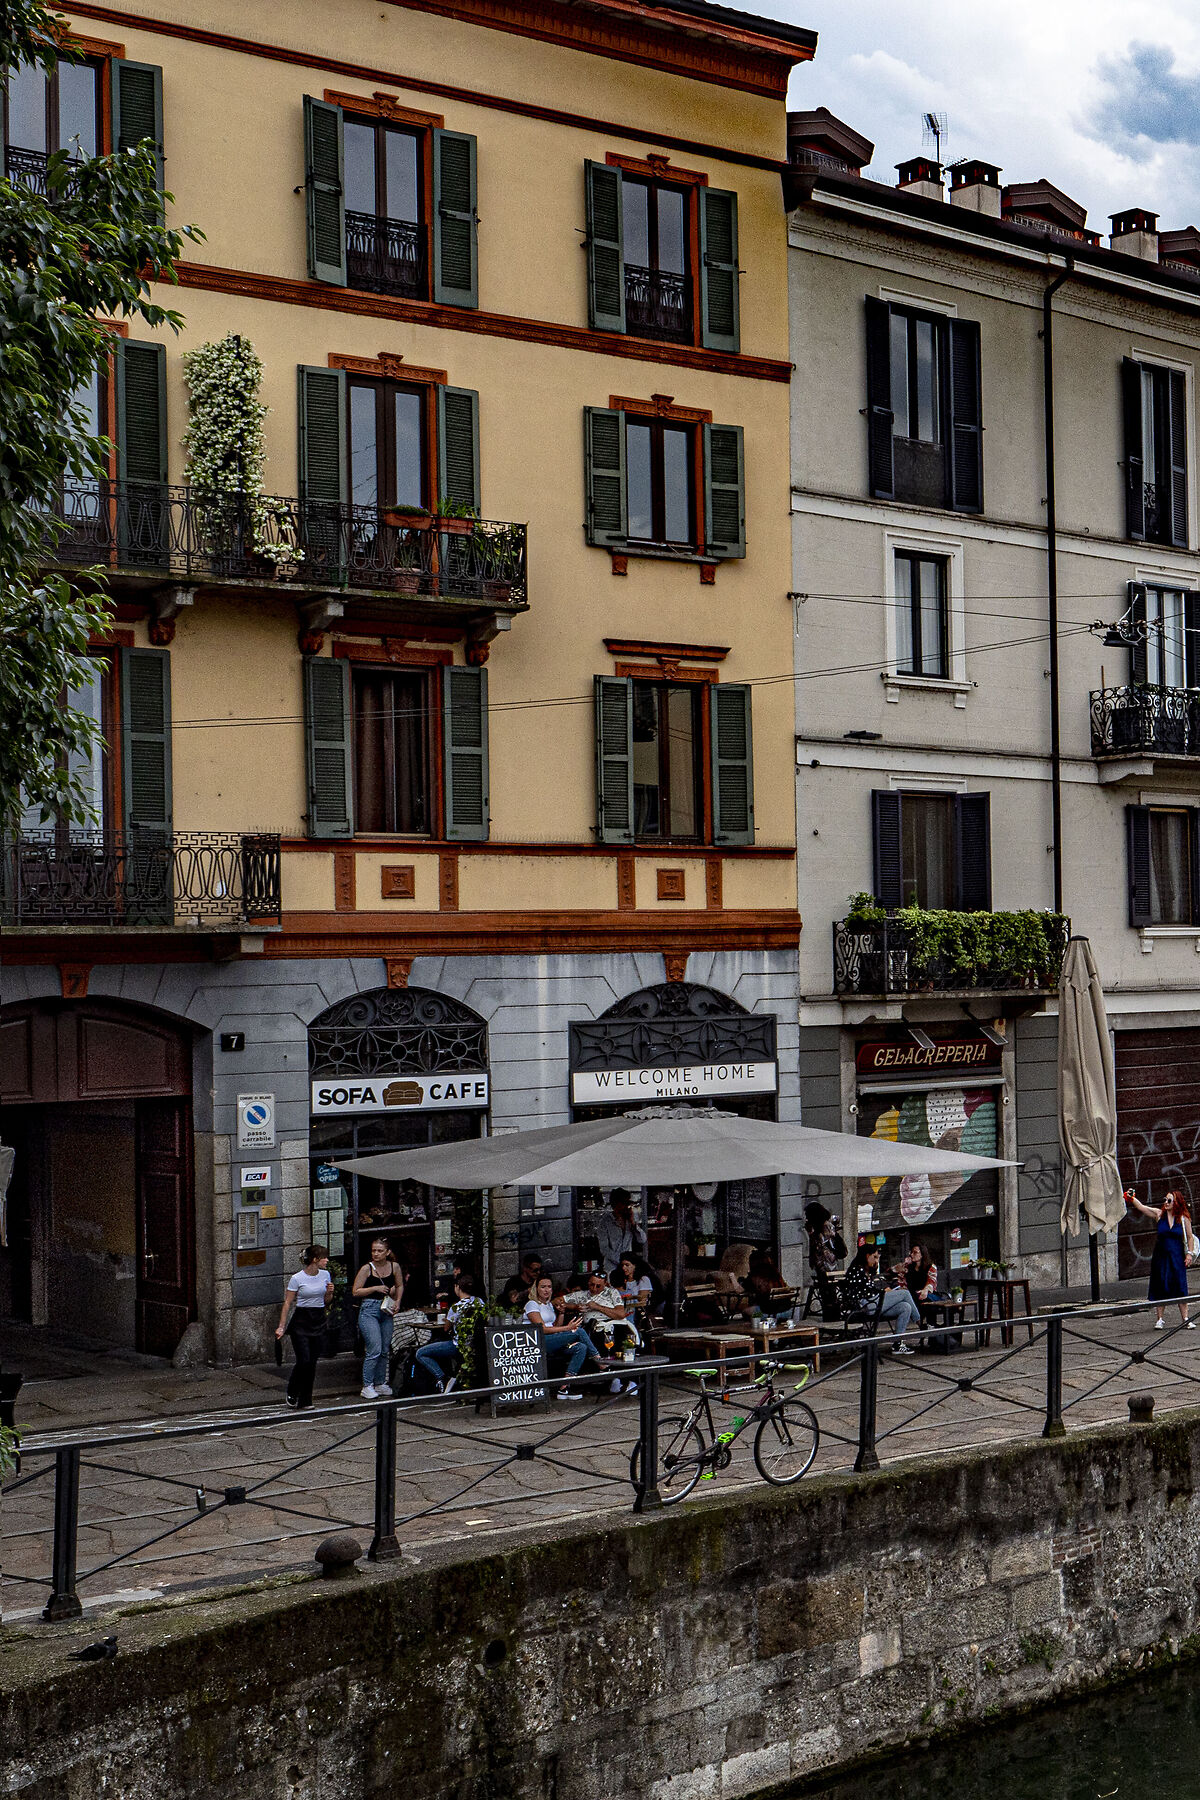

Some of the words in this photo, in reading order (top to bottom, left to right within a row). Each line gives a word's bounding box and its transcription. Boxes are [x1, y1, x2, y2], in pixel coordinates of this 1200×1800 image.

[69, 974, 82, 995] 7
[230, 1036, 238, 1048] 7
[873, 1044, 988, 1067] GELACREPERIA
[595, 1067, 692, 1088] WELCOME
[703, 1064, 756, 1081] HOME
[317, 1086, 378, 1106] SOFA
[429, 1081, 486, 1101] CAFE
[656, 1086, 699, 1097] MILANO
[319, 1174, 338, 1182] OPEN
[492, 1330, 538, 1349] OPEN
[498, 1347, 535, 1358] COFFEE
[493, 1355, 542, 1368] BREAKFAST
[502, 1365, 534, 1376] PANINI
[502, 1374, 539, 1386] DRINKS
